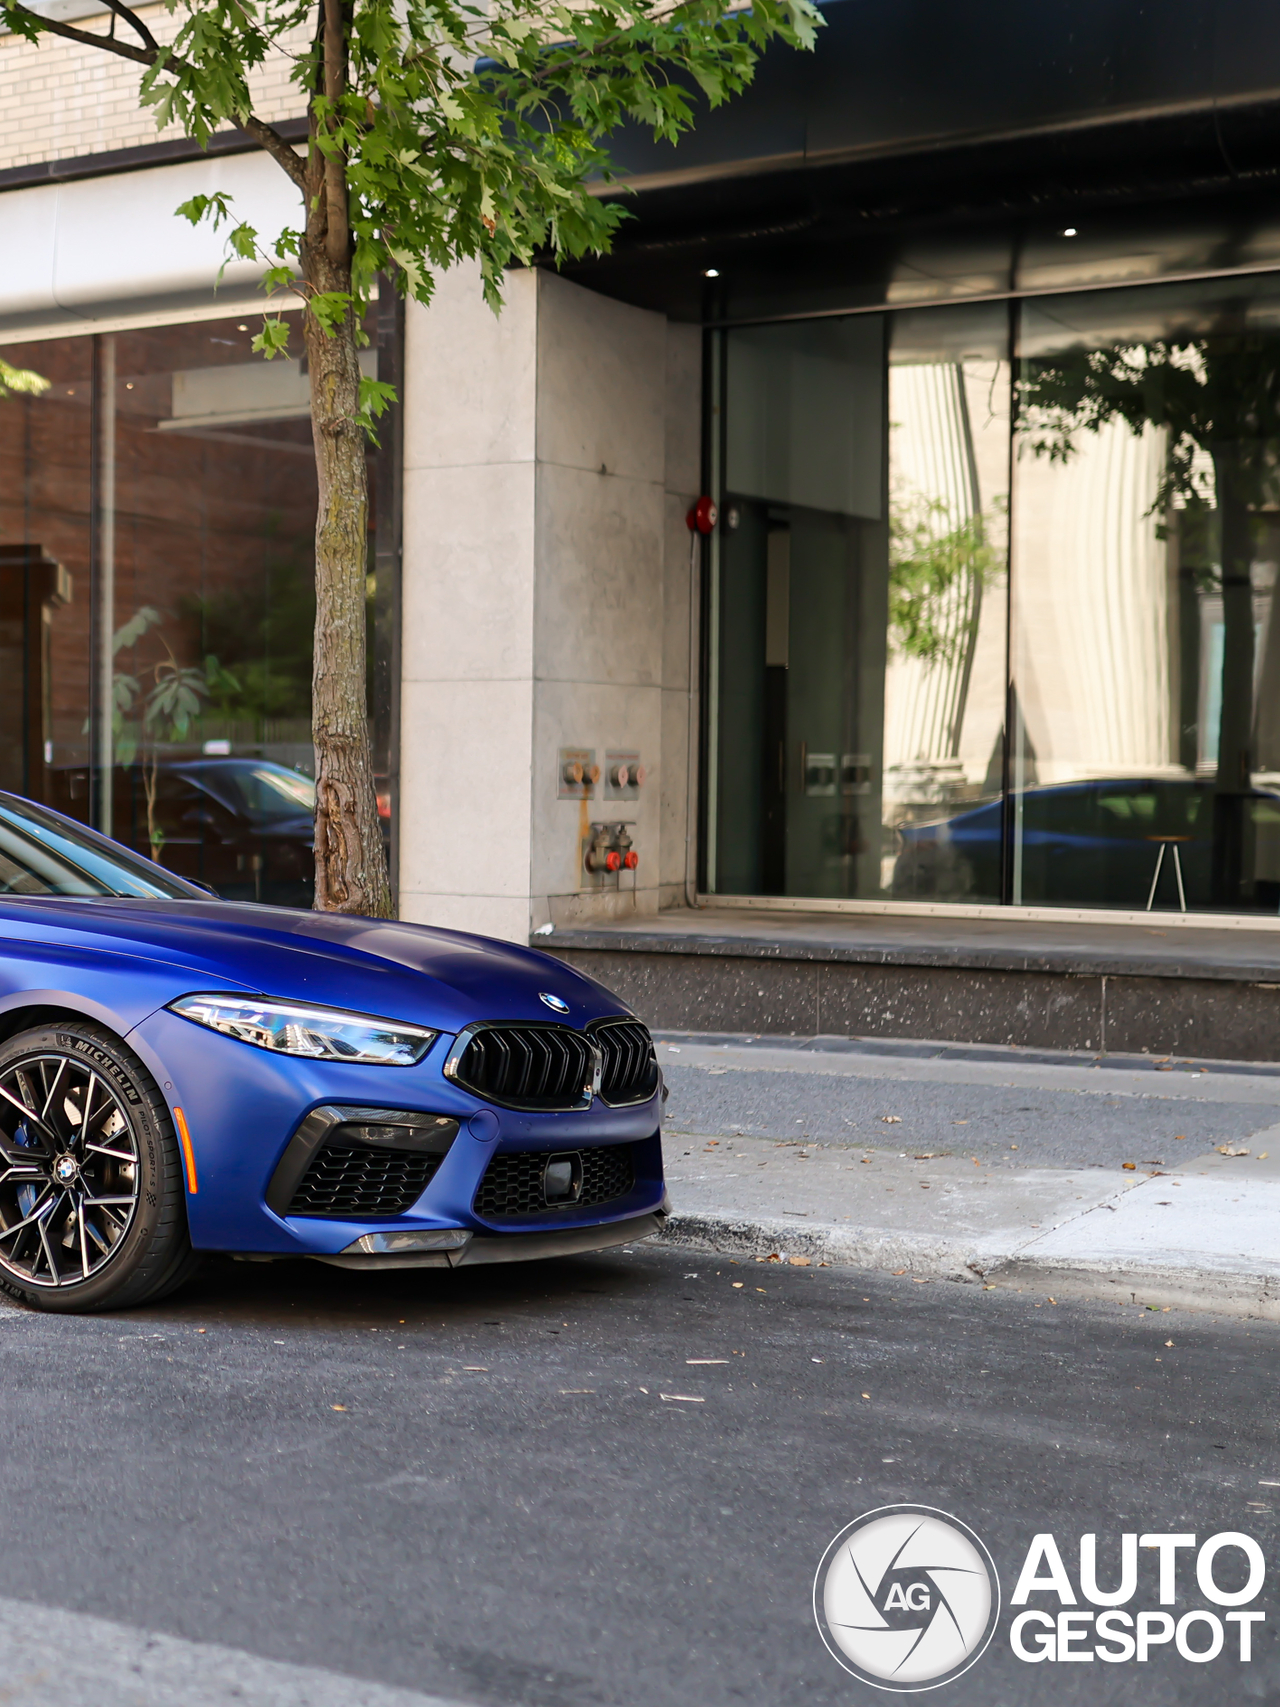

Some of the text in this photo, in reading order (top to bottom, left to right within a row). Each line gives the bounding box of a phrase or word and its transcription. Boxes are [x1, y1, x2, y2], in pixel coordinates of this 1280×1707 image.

[75, 1040, 139, 1101] MICHELIN
[138, 1111, 151, 1137] PILOT
[146, 1140, 156, 1173] SPORT
